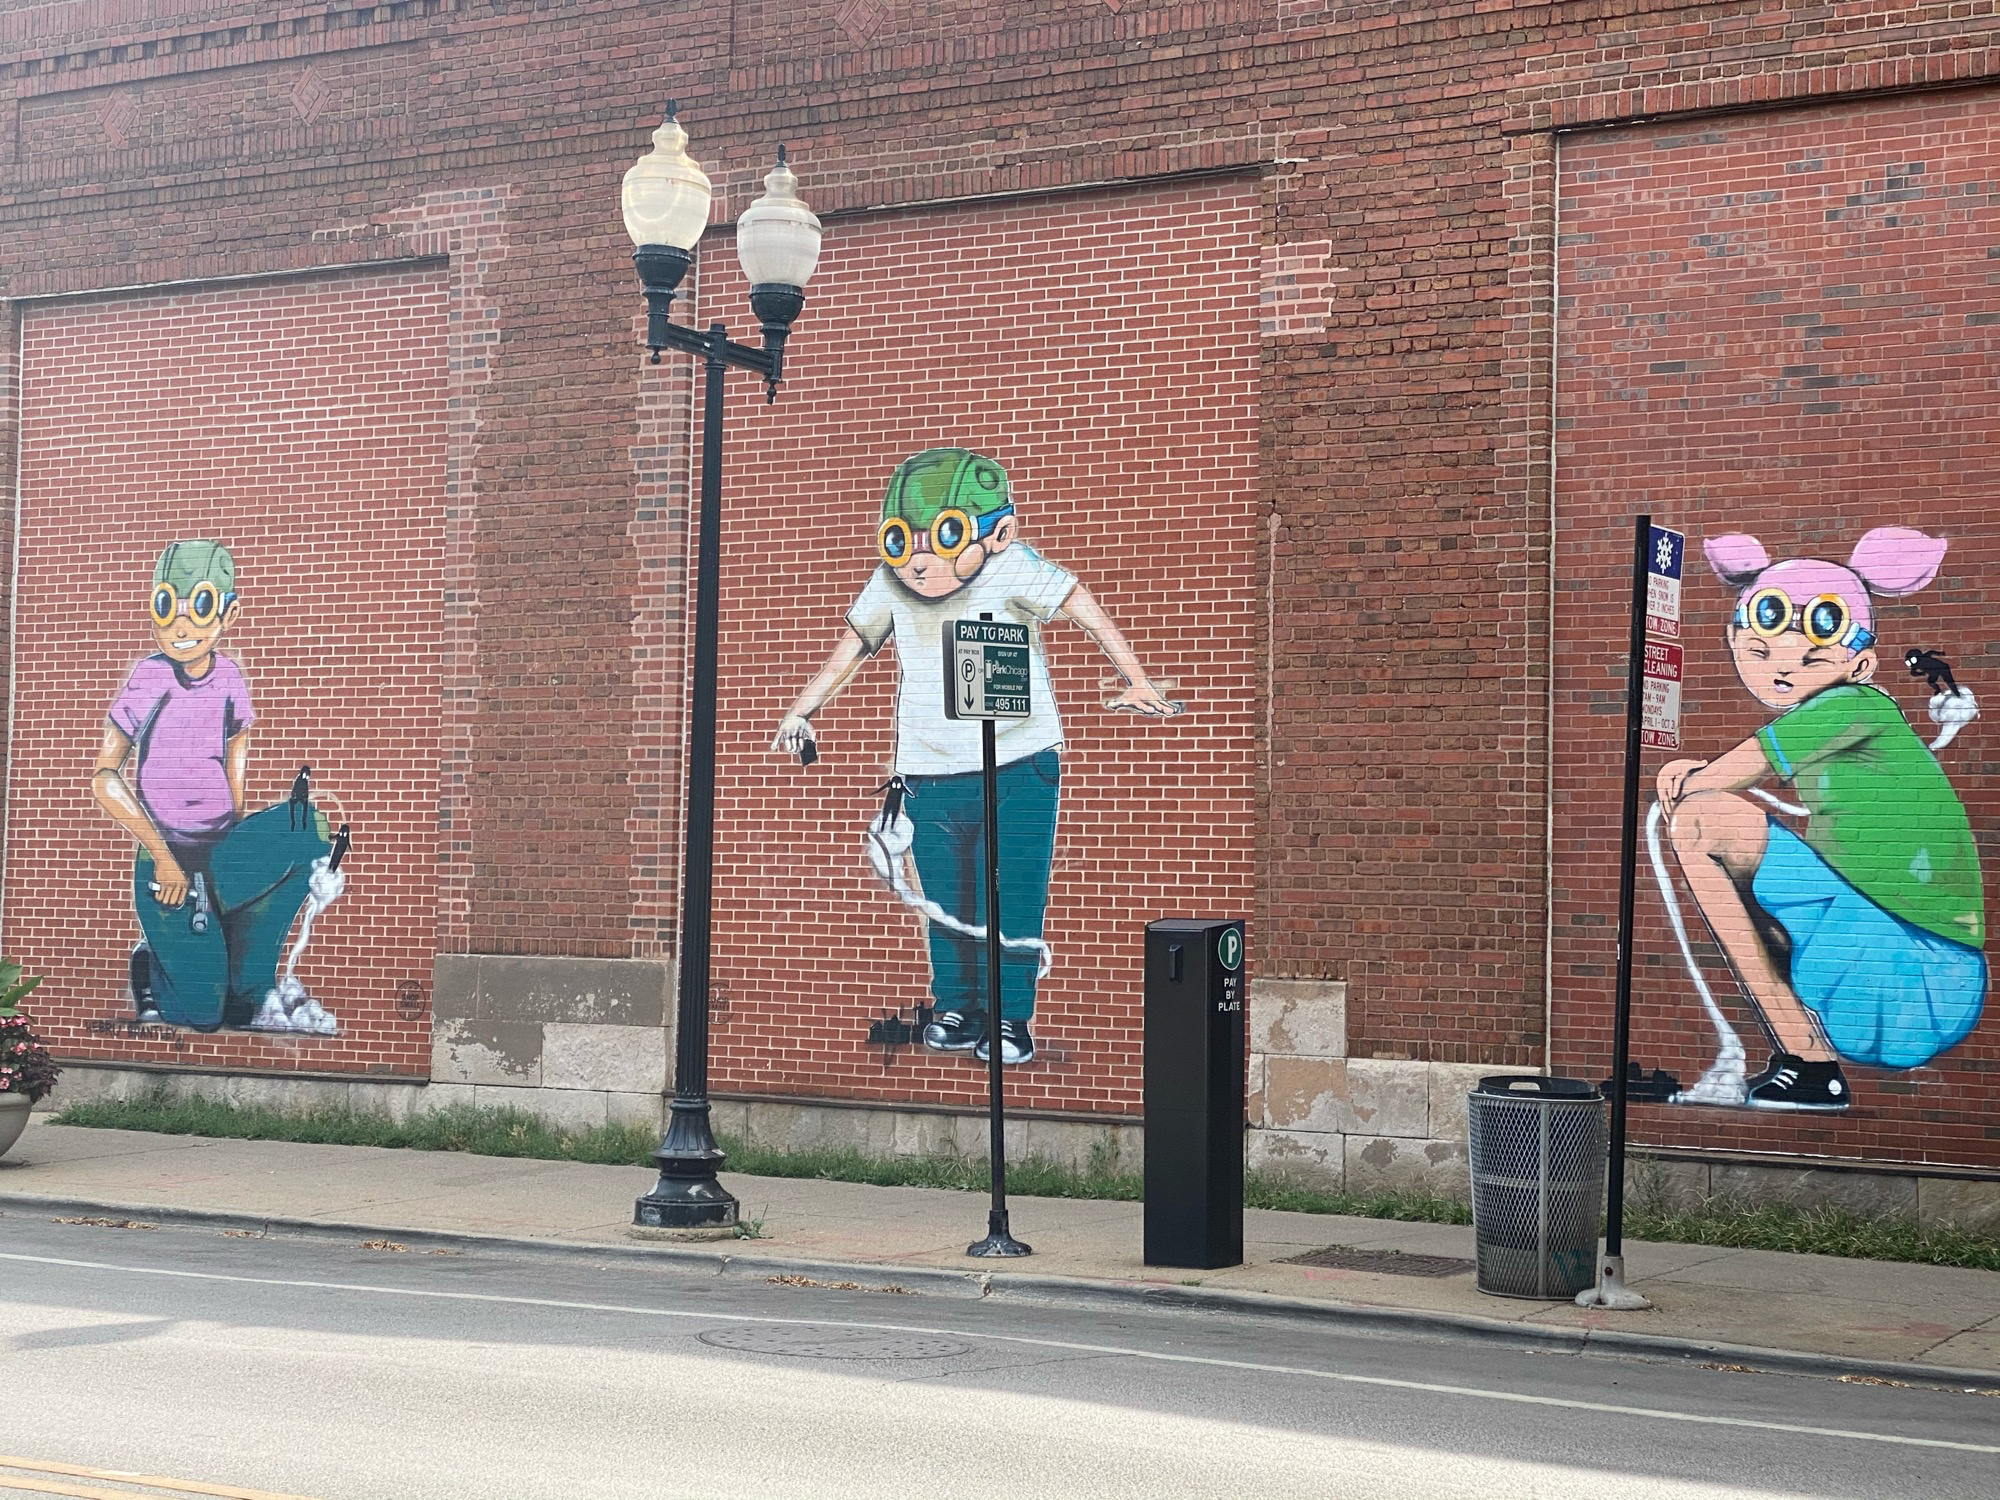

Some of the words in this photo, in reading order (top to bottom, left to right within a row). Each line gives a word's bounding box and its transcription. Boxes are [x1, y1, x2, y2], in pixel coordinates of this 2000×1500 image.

[960, 625, 979, 640] PAY
[981, 626, 996, 641] TO
[998, 627, 1024, 642] PARK
[1660, 619, 1676, 635] ZONE
[1644, 644, 1669, 661] STREET
[965, 663, 973, 678] P
[992, 664, 1028, 678] ParkChicago
[1643, 659, 1678, 678] CLEANING
[1650, 681, 1669, 693] PARKING
[995, 698, 1010, 710] 495
[1012, 698, 1026, 711] 111
[1661, 718, 1670, 728] OCT
[1641, 730, 1655, 743] TOW
[1657, 732, 1676, 747] ZONE
[1227, 935, 1238, 964] P
[1223, 978, 1237, 987] PAY
[1225, 990, 1235, 999] BY
[1218, 1001, 1240, 1012] PLATE
